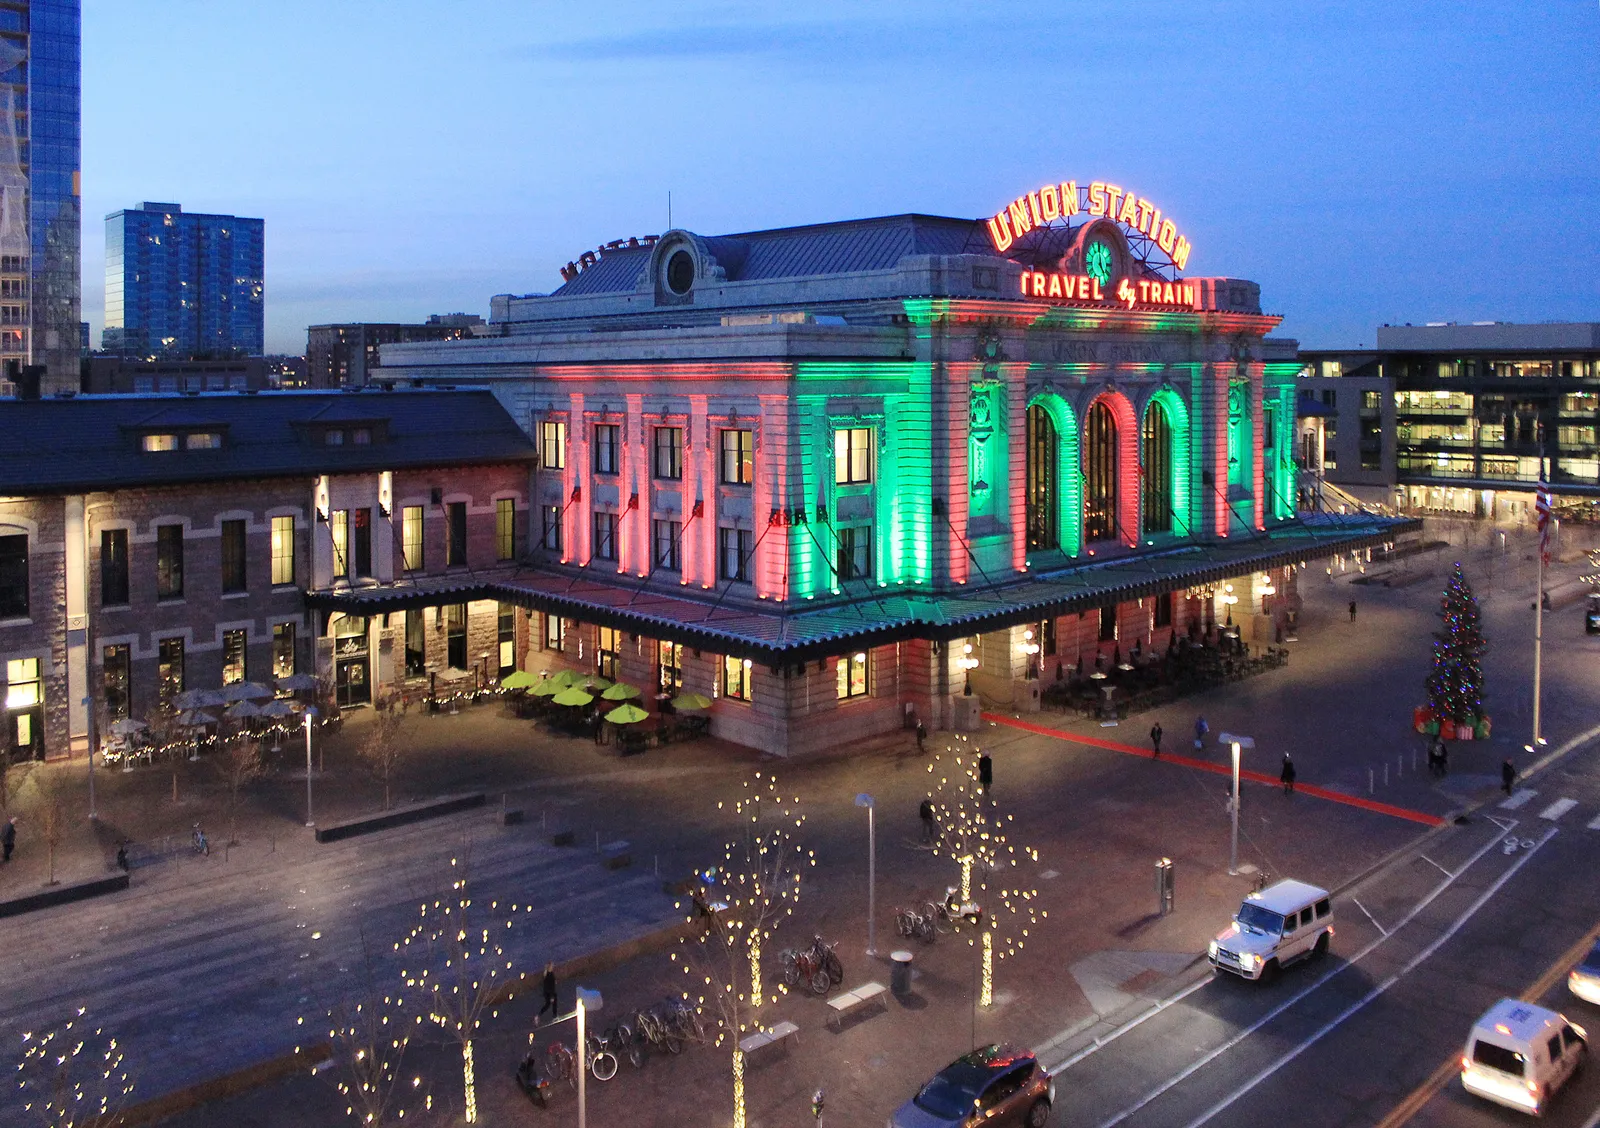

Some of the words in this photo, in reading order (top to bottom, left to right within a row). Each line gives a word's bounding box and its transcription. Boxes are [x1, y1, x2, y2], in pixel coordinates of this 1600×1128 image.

[987, 180, 1079, 251] UNION
[1088, 181, 1193, 271] STATION
[1020, 271, 1104, 301] TRAVEL
[1117, 278, 1137, 310] by
[1140, 280, 1195, 306] TRAIN
[1052, 341, 1097, 360] UNION
